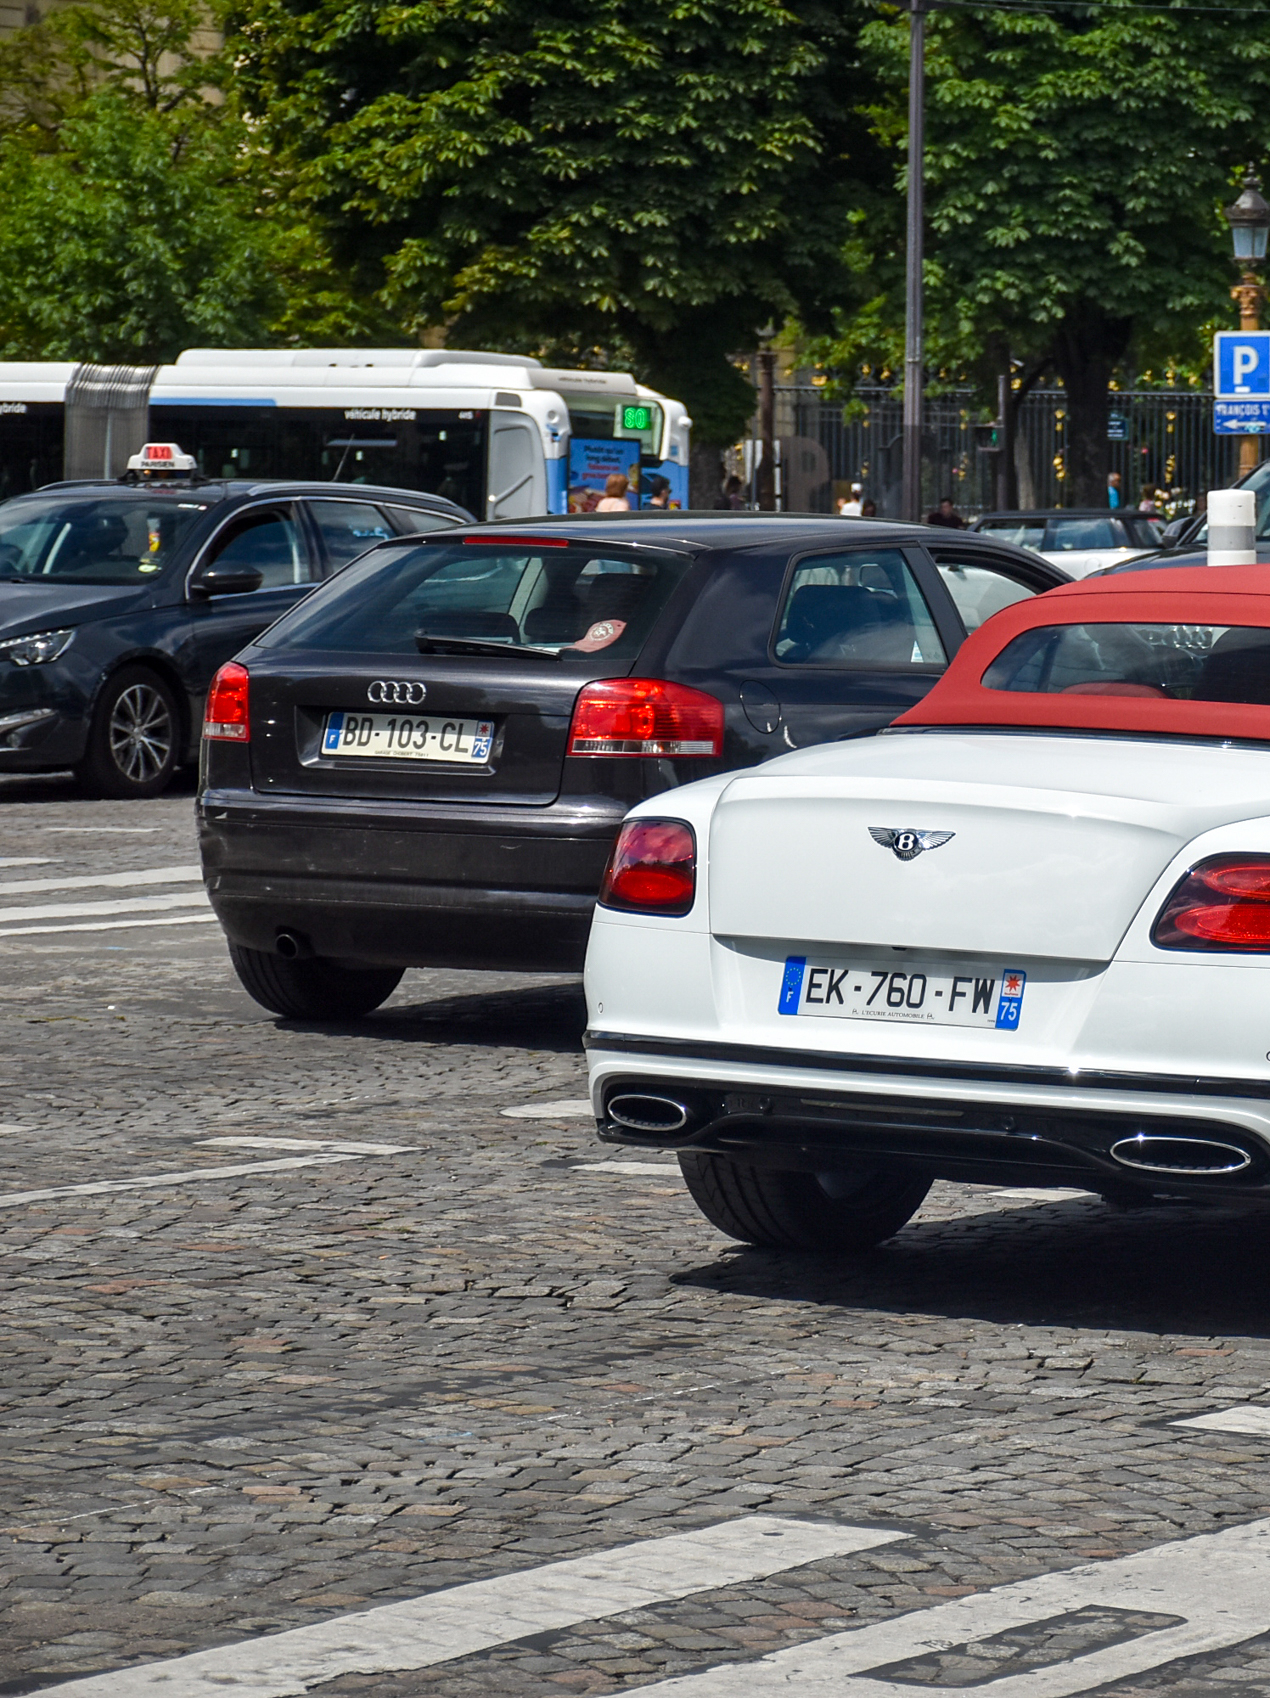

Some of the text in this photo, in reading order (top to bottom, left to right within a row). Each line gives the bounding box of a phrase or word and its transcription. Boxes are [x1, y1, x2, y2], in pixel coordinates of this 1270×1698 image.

[1233, 345, 1259, 385] P
[344, 408, 417, 422] véhicule hybride
[624, 407, 647, 429] 80
[145, 446, 171, 459] TAXI
[328, 716, 488, 756] F BD-103-CL 75
[786, 968, 1018, 1021] F EK-760-FW 75
[887, 1011, 925, 1019] AUTOMOBILE
